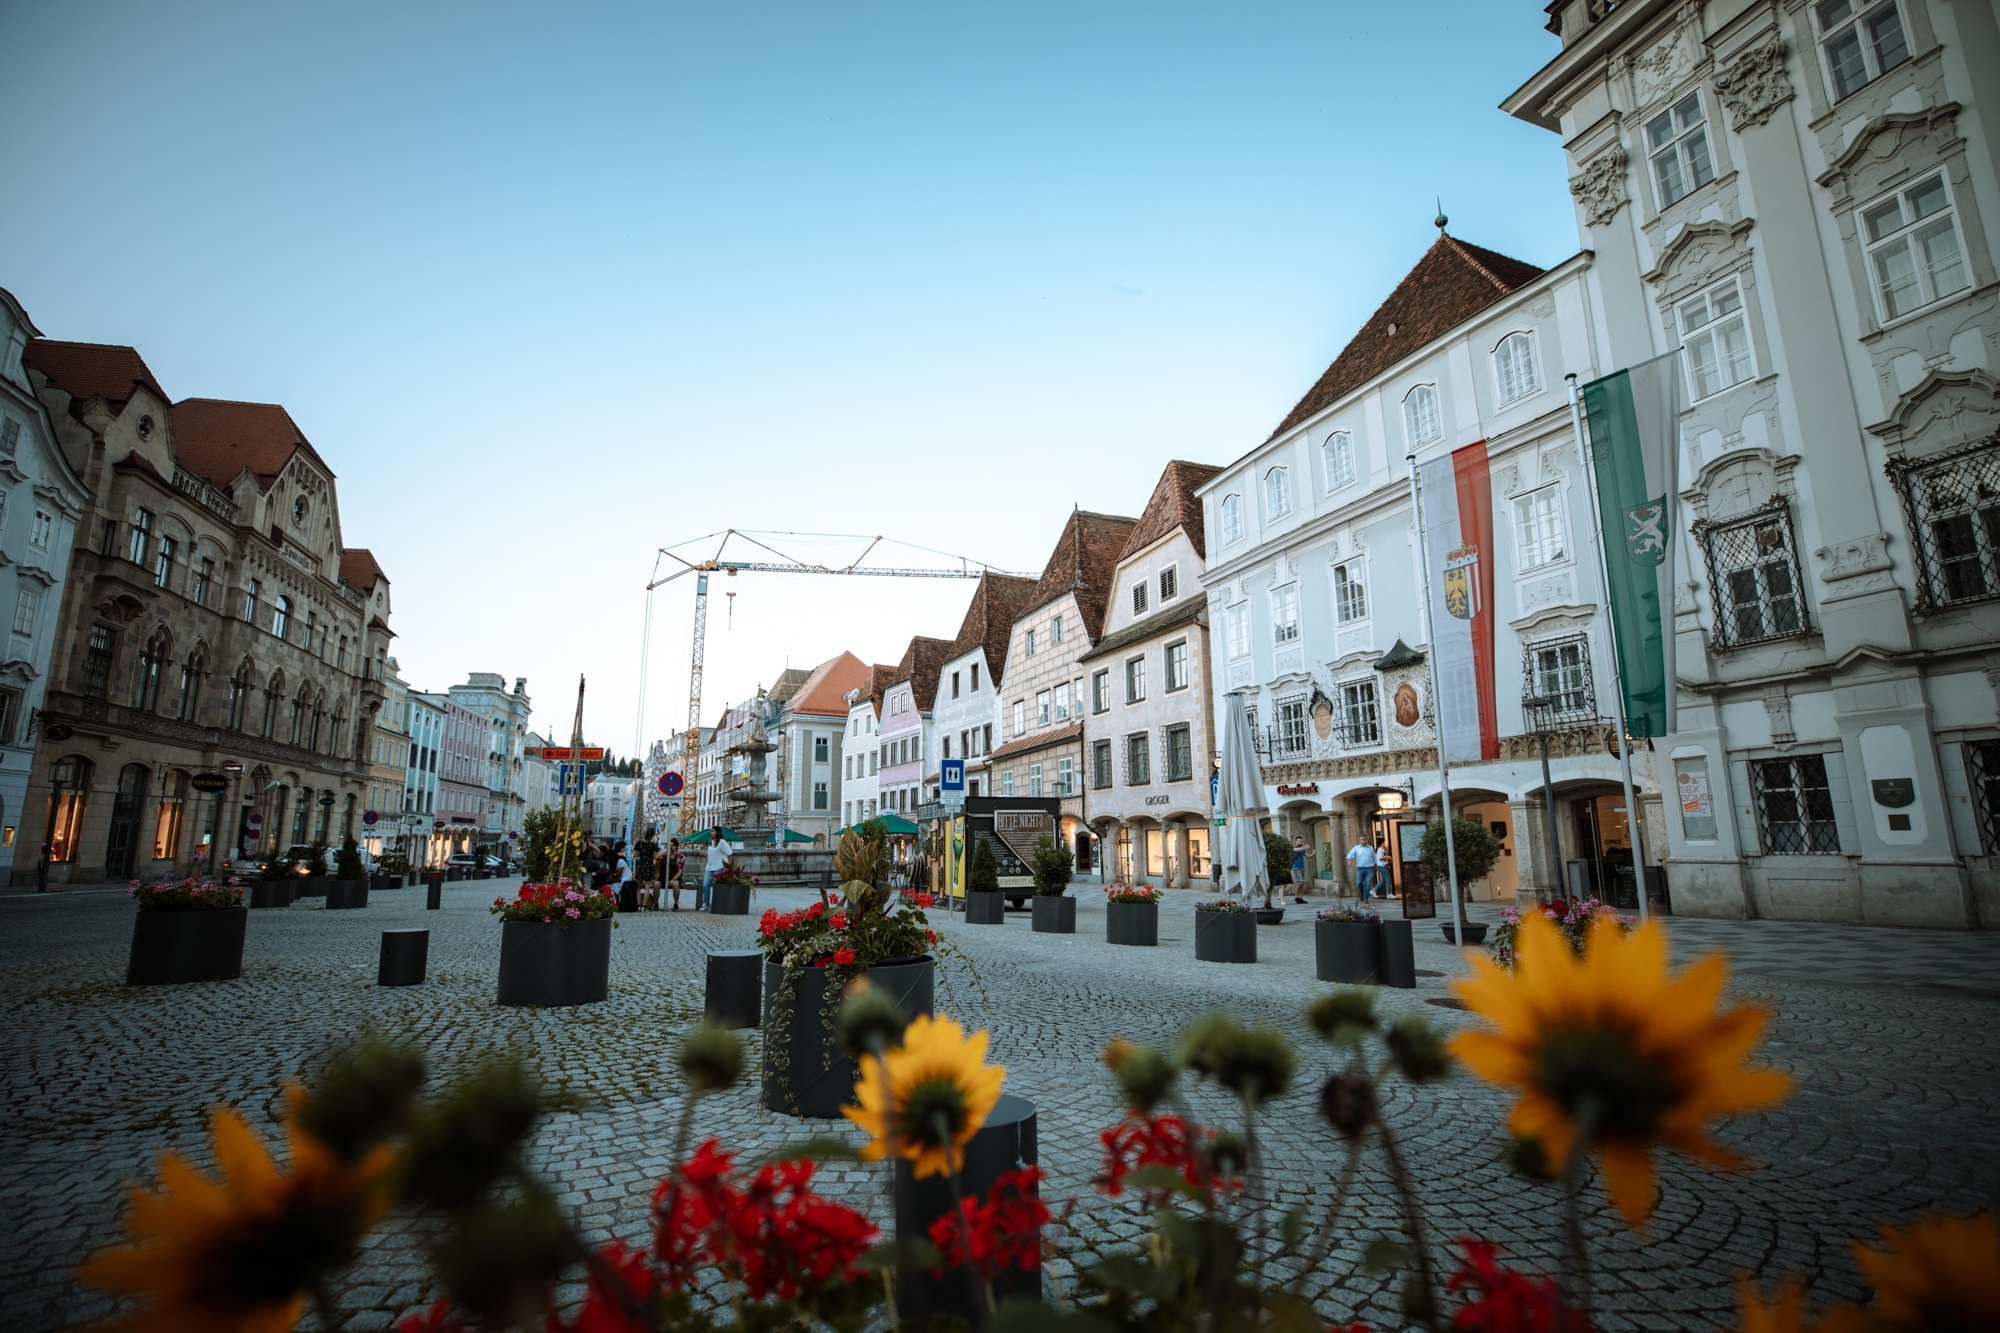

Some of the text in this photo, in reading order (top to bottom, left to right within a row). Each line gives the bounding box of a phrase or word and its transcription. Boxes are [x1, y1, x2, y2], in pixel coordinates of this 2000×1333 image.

[555, 750, 599, 758] Stadasfahrt
[1277, 783, 1318, 796] Oberbank
[1680, 785, 1699, 794] SEX
[998, 814, 1018, 828] BITTE
